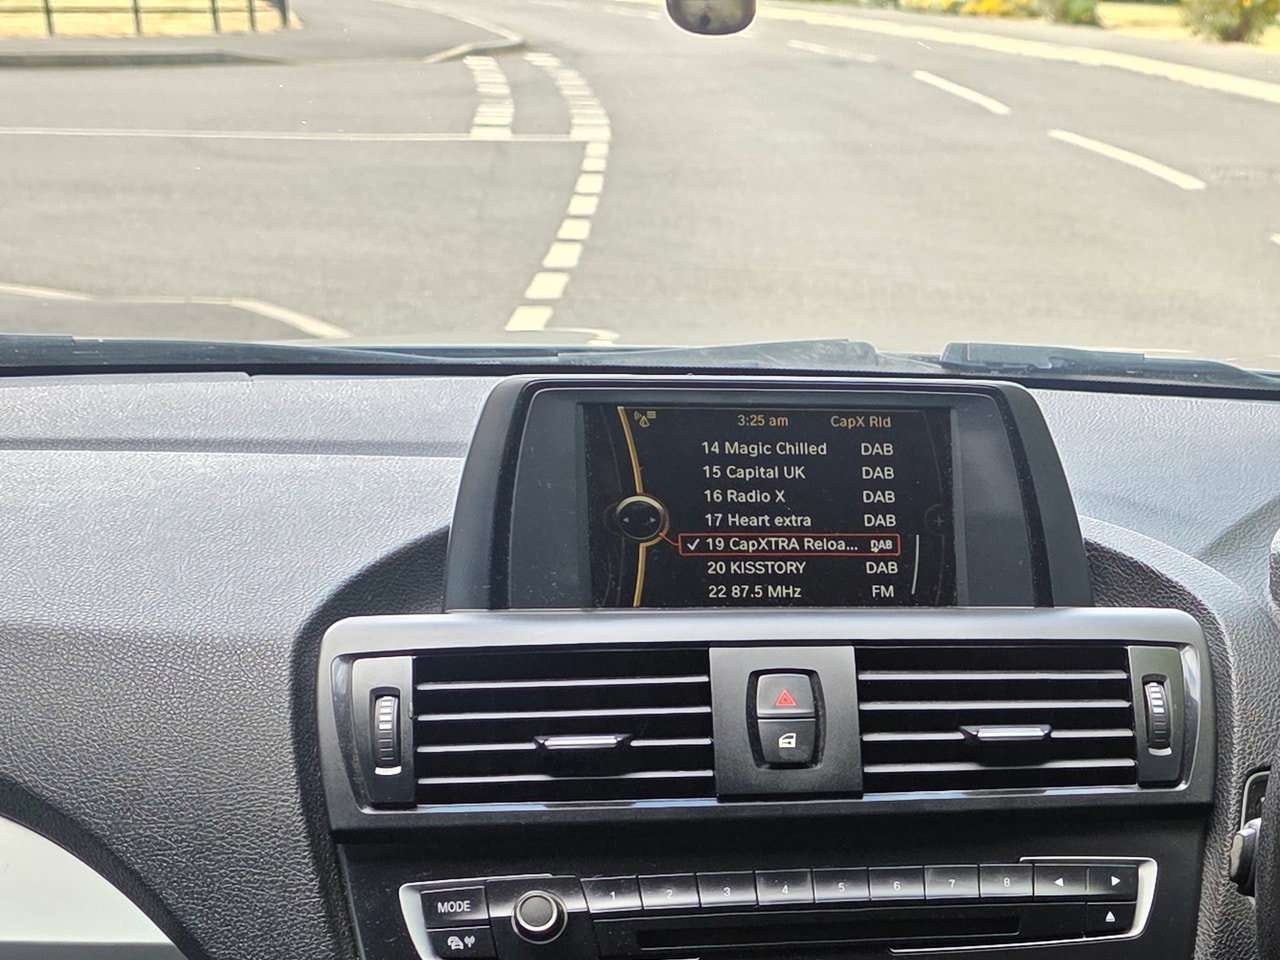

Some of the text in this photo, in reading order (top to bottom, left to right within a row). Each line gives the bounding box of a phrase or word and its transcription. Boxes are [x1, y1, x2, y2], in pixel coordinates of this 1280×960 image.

[737, 415, 789, 427] 3:25 am
[830, 416, 892, 429] CapX Rld
[702, 442, 894, 457] 14 Magic Chilled DAB
[703, 466, 895, 480] 15 Capital UK DAB
[704, 490, 896, 503] 16 Radio X DAB
[705, 514, 897, 527] 17 Heart extra DAB
[706, 538, 725, 551] 19
[729, 538, 800, 554] CapXTRA
[871, 540, 893, 552] DAB
[707, 561, 899, 575] 20 KISSTORY DAB
[708, 586, 895, 598] 22 87.5 MHz FM
[610, 877, 1010, 900] 1 2 3 4 5 6 7 8
[437, 900, 471, 914] MODE
